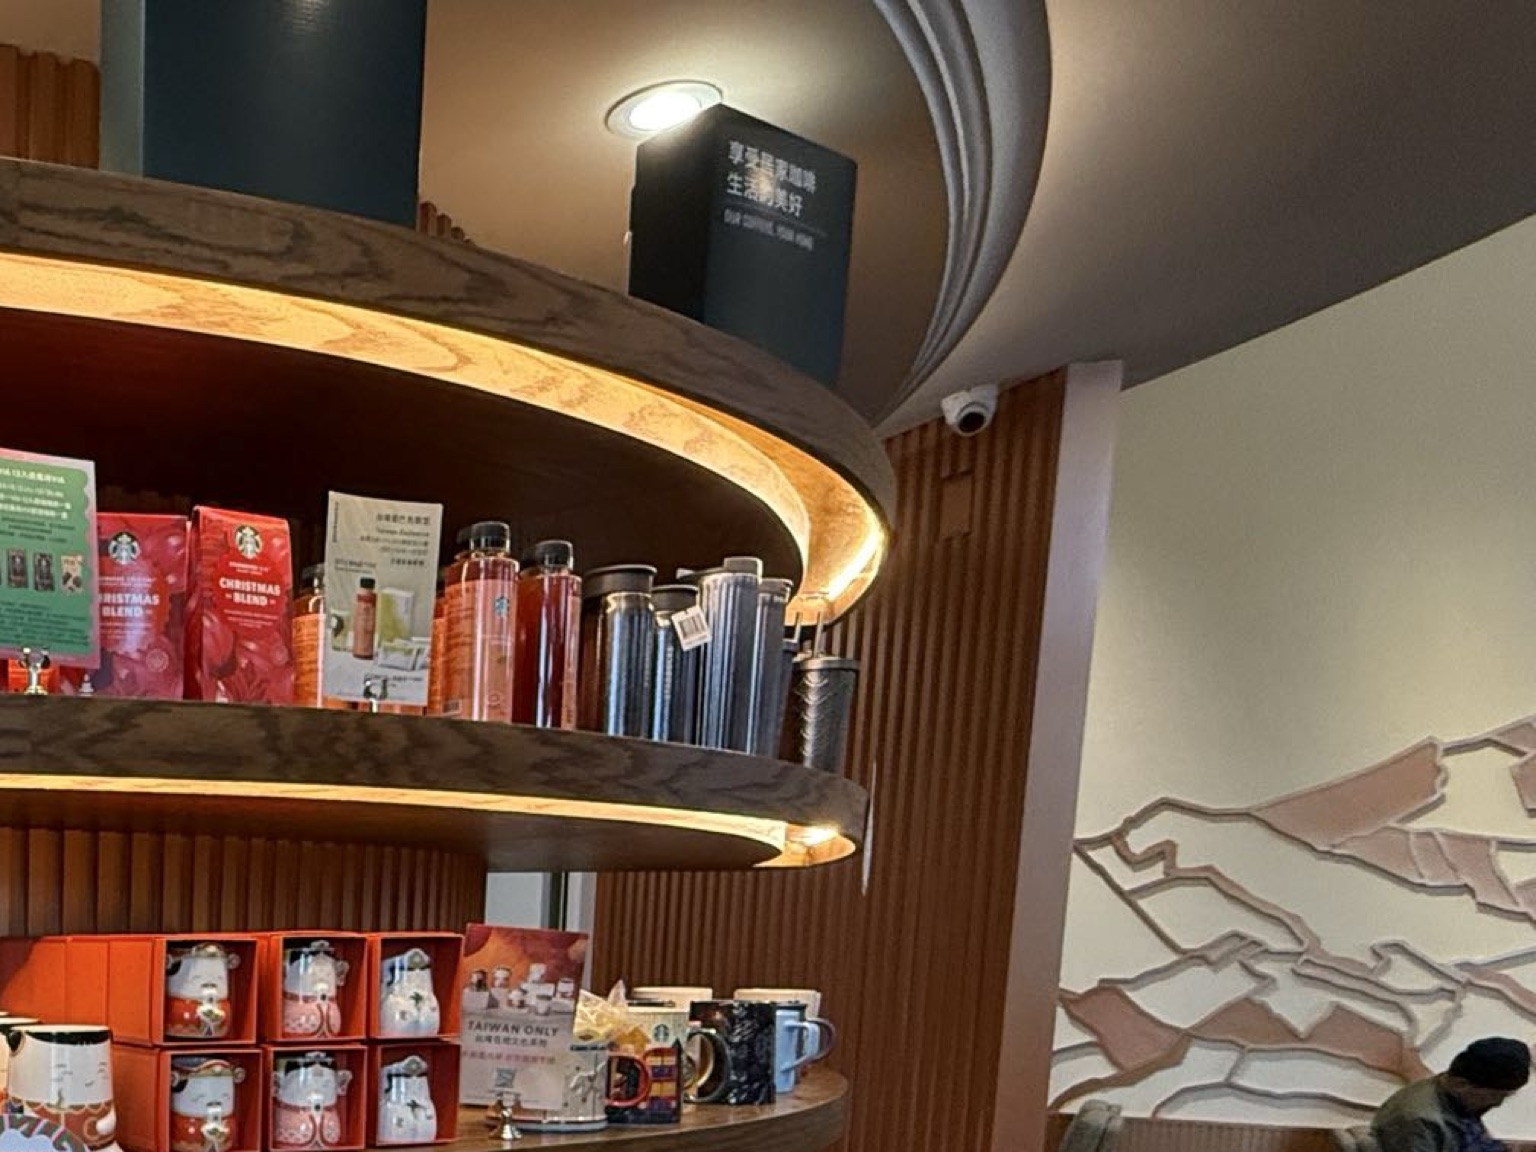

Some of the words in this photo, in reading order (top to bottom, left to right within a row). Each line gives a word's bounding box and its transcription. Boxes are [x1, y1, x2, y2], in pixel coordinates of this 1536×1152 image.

[218, 577, 281, 597] CHRISTMAS
[232, 592, 268, 606] BLEND
[102, 605, 144, 617] BLEND
[467, 1020, 521, 1035] TAIWAN
[523, 1024, 559, 1037] ONLY
